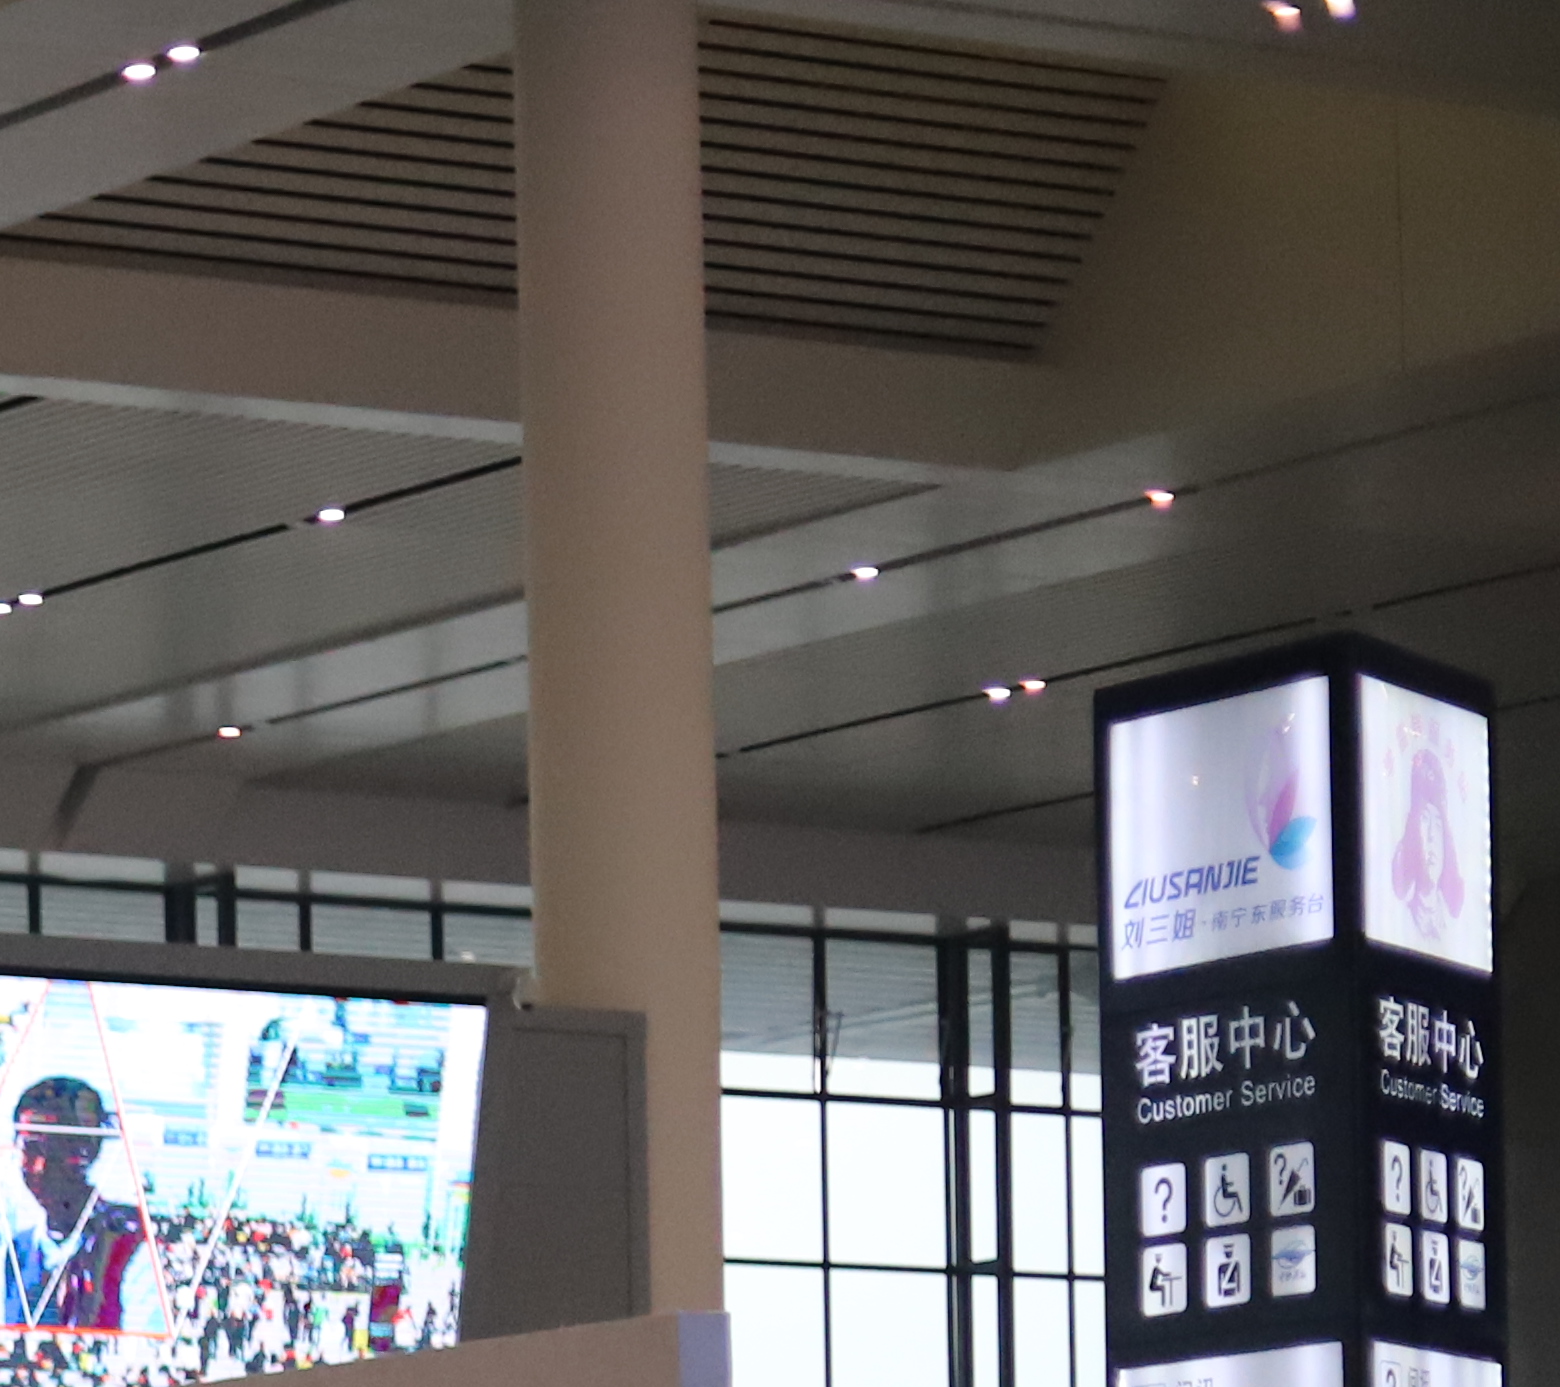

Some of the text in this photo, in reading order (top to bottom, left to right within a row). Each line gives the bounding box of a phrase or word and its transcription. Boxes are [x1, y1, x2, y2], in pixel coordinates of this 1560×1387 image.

[1124, 856, 1261, 909] LIUSANJIE
[1135, 1000, 1316, 1088] 客服中心
[1379, 996, 1484, 1079] 客服中心
[1137, 1074, 1316, 1124] Customer Service
[1381, 1068, 1484, 1118] Customer Service
